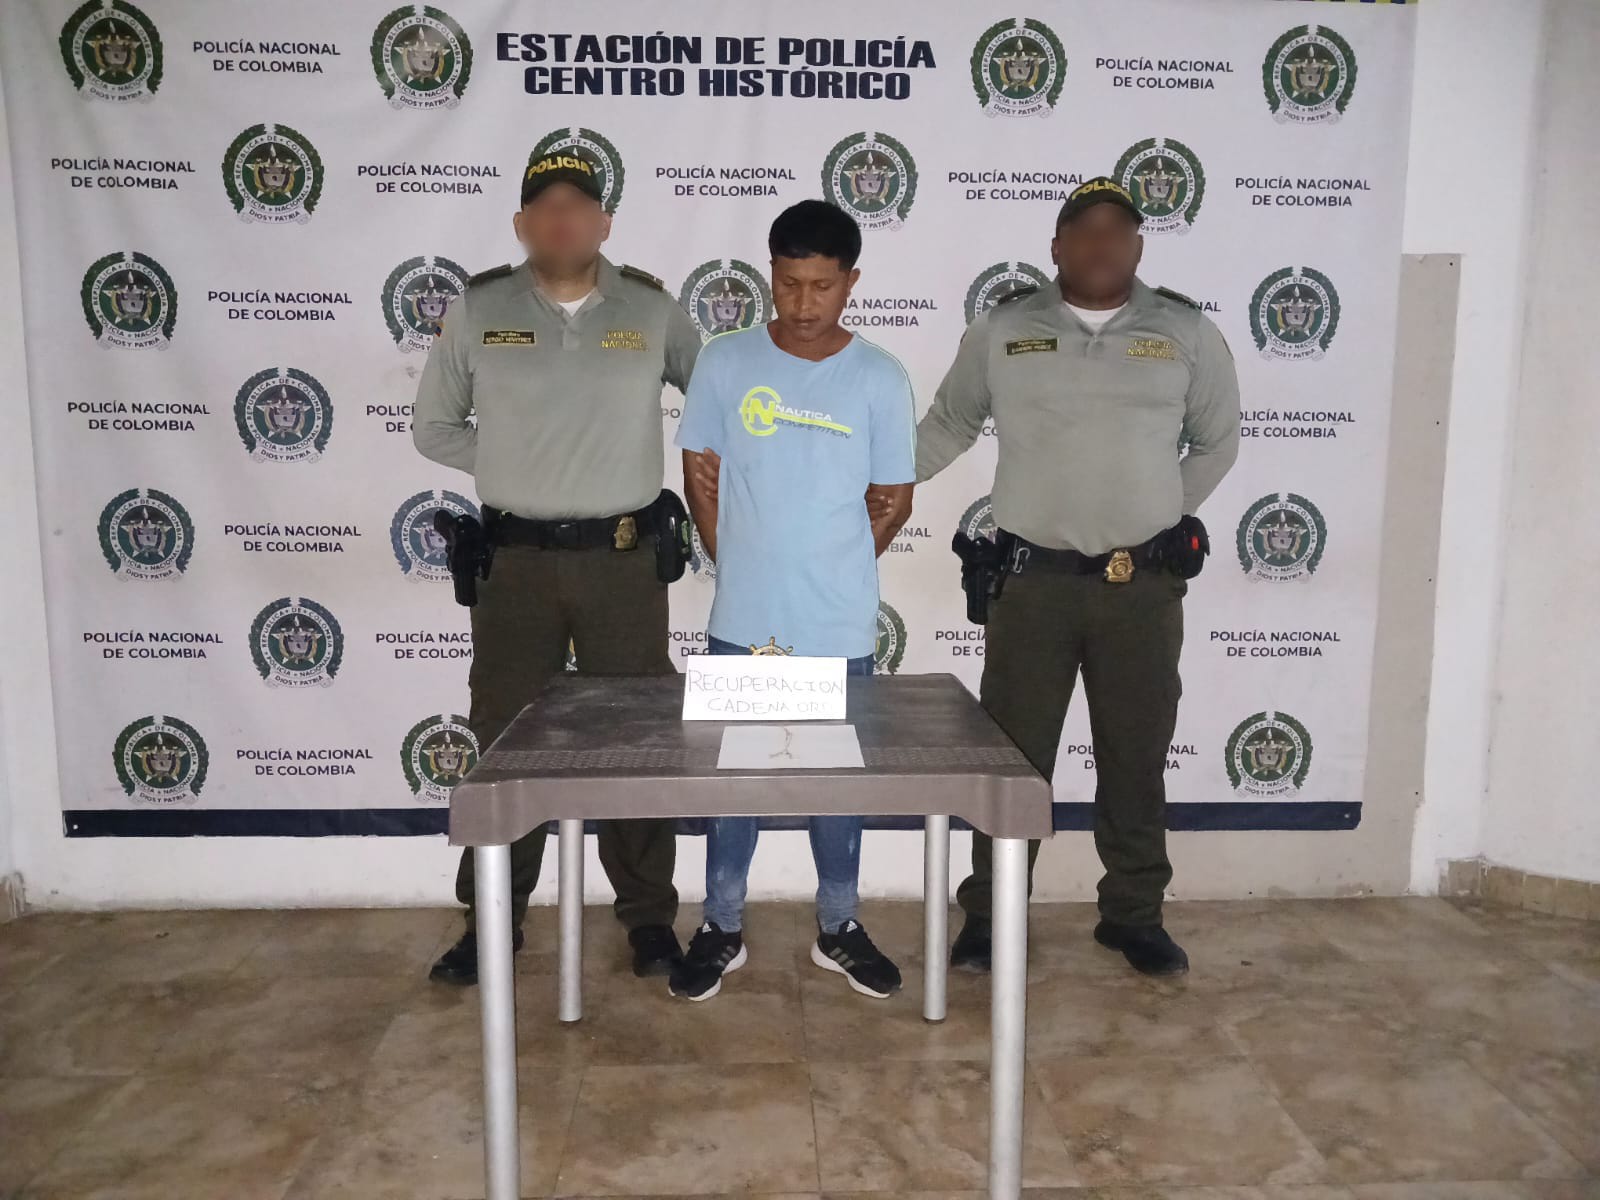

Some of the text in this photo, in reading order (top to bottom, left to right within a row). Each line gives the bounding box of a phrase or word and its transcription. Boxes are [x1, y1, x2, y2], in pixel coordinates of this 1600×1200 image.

[193, 38, 341, 56] POLICÍA NACIONAL
[436, 22, 460, 64] COLOMBIA
[496, 31, 936, 69] ESTACIÓN DE POLICÍA
[1034, 33, 1055, 73] COLOMBIA
[212, 59, 324, 74] DE COLOMBIA
[1095, 56, 1234, 73] POLICÍA NACIONAL
[524, 66, 911, 100] CENTRO HISTÓRICO
[1113, 75, 1215, 90] DE COLOMBIA
[51, 156, 196, 173] POLICÍA NACIONAL
[285, 140, 312, 181] COLOMBIA
[357, 161, 502, 178] POLICÍA NACIONAL
[655, 164, 797, 181] POLICÍA NACIONAL
[948, 168, 1085, 186] POLICÍA NACIONAL
[70, 175, 179, 190] DE COLOMBIA
[375, 181, 484, 195] DE COLOMBIA
[1235, 175, 1371, 191] POLICÍA NACIONAL
[674, 184, 779, 197] DE COLOMBIA
[965, 188, 1067, 202] DE COLOMBIA
[1251, 194, 1353, 207] DE COLOMBIA
[143, 268, 167, 307] COLOMBIA
[207, 289, 353, 305] POLICÍA NACIONAL
[862, 298, 938, 310] NACIONAL
[1310, 281, 1329, 319] COLOMBIA
[228, 308, 336, 321] DE COLOMBIA
[841, 315, 919, 327] COLOMBIA
[67, 399, 211, 415] POLICÍA NACIONAL
[297, 383, 321, 421] COLOMBIA
[366, 402, 415, 416] POLICÍ
[775, 404, 832, 421] NAUTICA
[1240, 407, 1356, 423] LICÍA NACIONAL
[88, 418, 196, 432] DE COLOMBIA
[385, 421, 406, 433] DE
[1240, 426, 1337, 439] DE COLOMBIA
[224, 522, 362, 537] POLICÍA NACIONAL
[243, 540, 345, 553] DE COLOMBIA
[83, 629, 224, 644] POLICÍA NACIONAL
[309, 612, 332, 649] COLOMBIA
[375, 630, 435, 643] POLICÍA
[1210, 629, 1341, 643] POLICÍA NACIONAL
[102, 647, 207, 659] DE COLOMBIA
[394, 647, 472, 659] DE COLOM
[952, 645, 971, 656] DE
[1226, 646, 1323, 658] DE COLOMBIA
[688, 669, 844, 694] RECUPERACION
[707, 697, 790, 715] CADENA
[1282, 725, 1302, 760] COLOMBIA
[236, 747, 374, 761] POLICÍA NACIONAL
[254, 764, 356, 777] DE COLOMBIA
